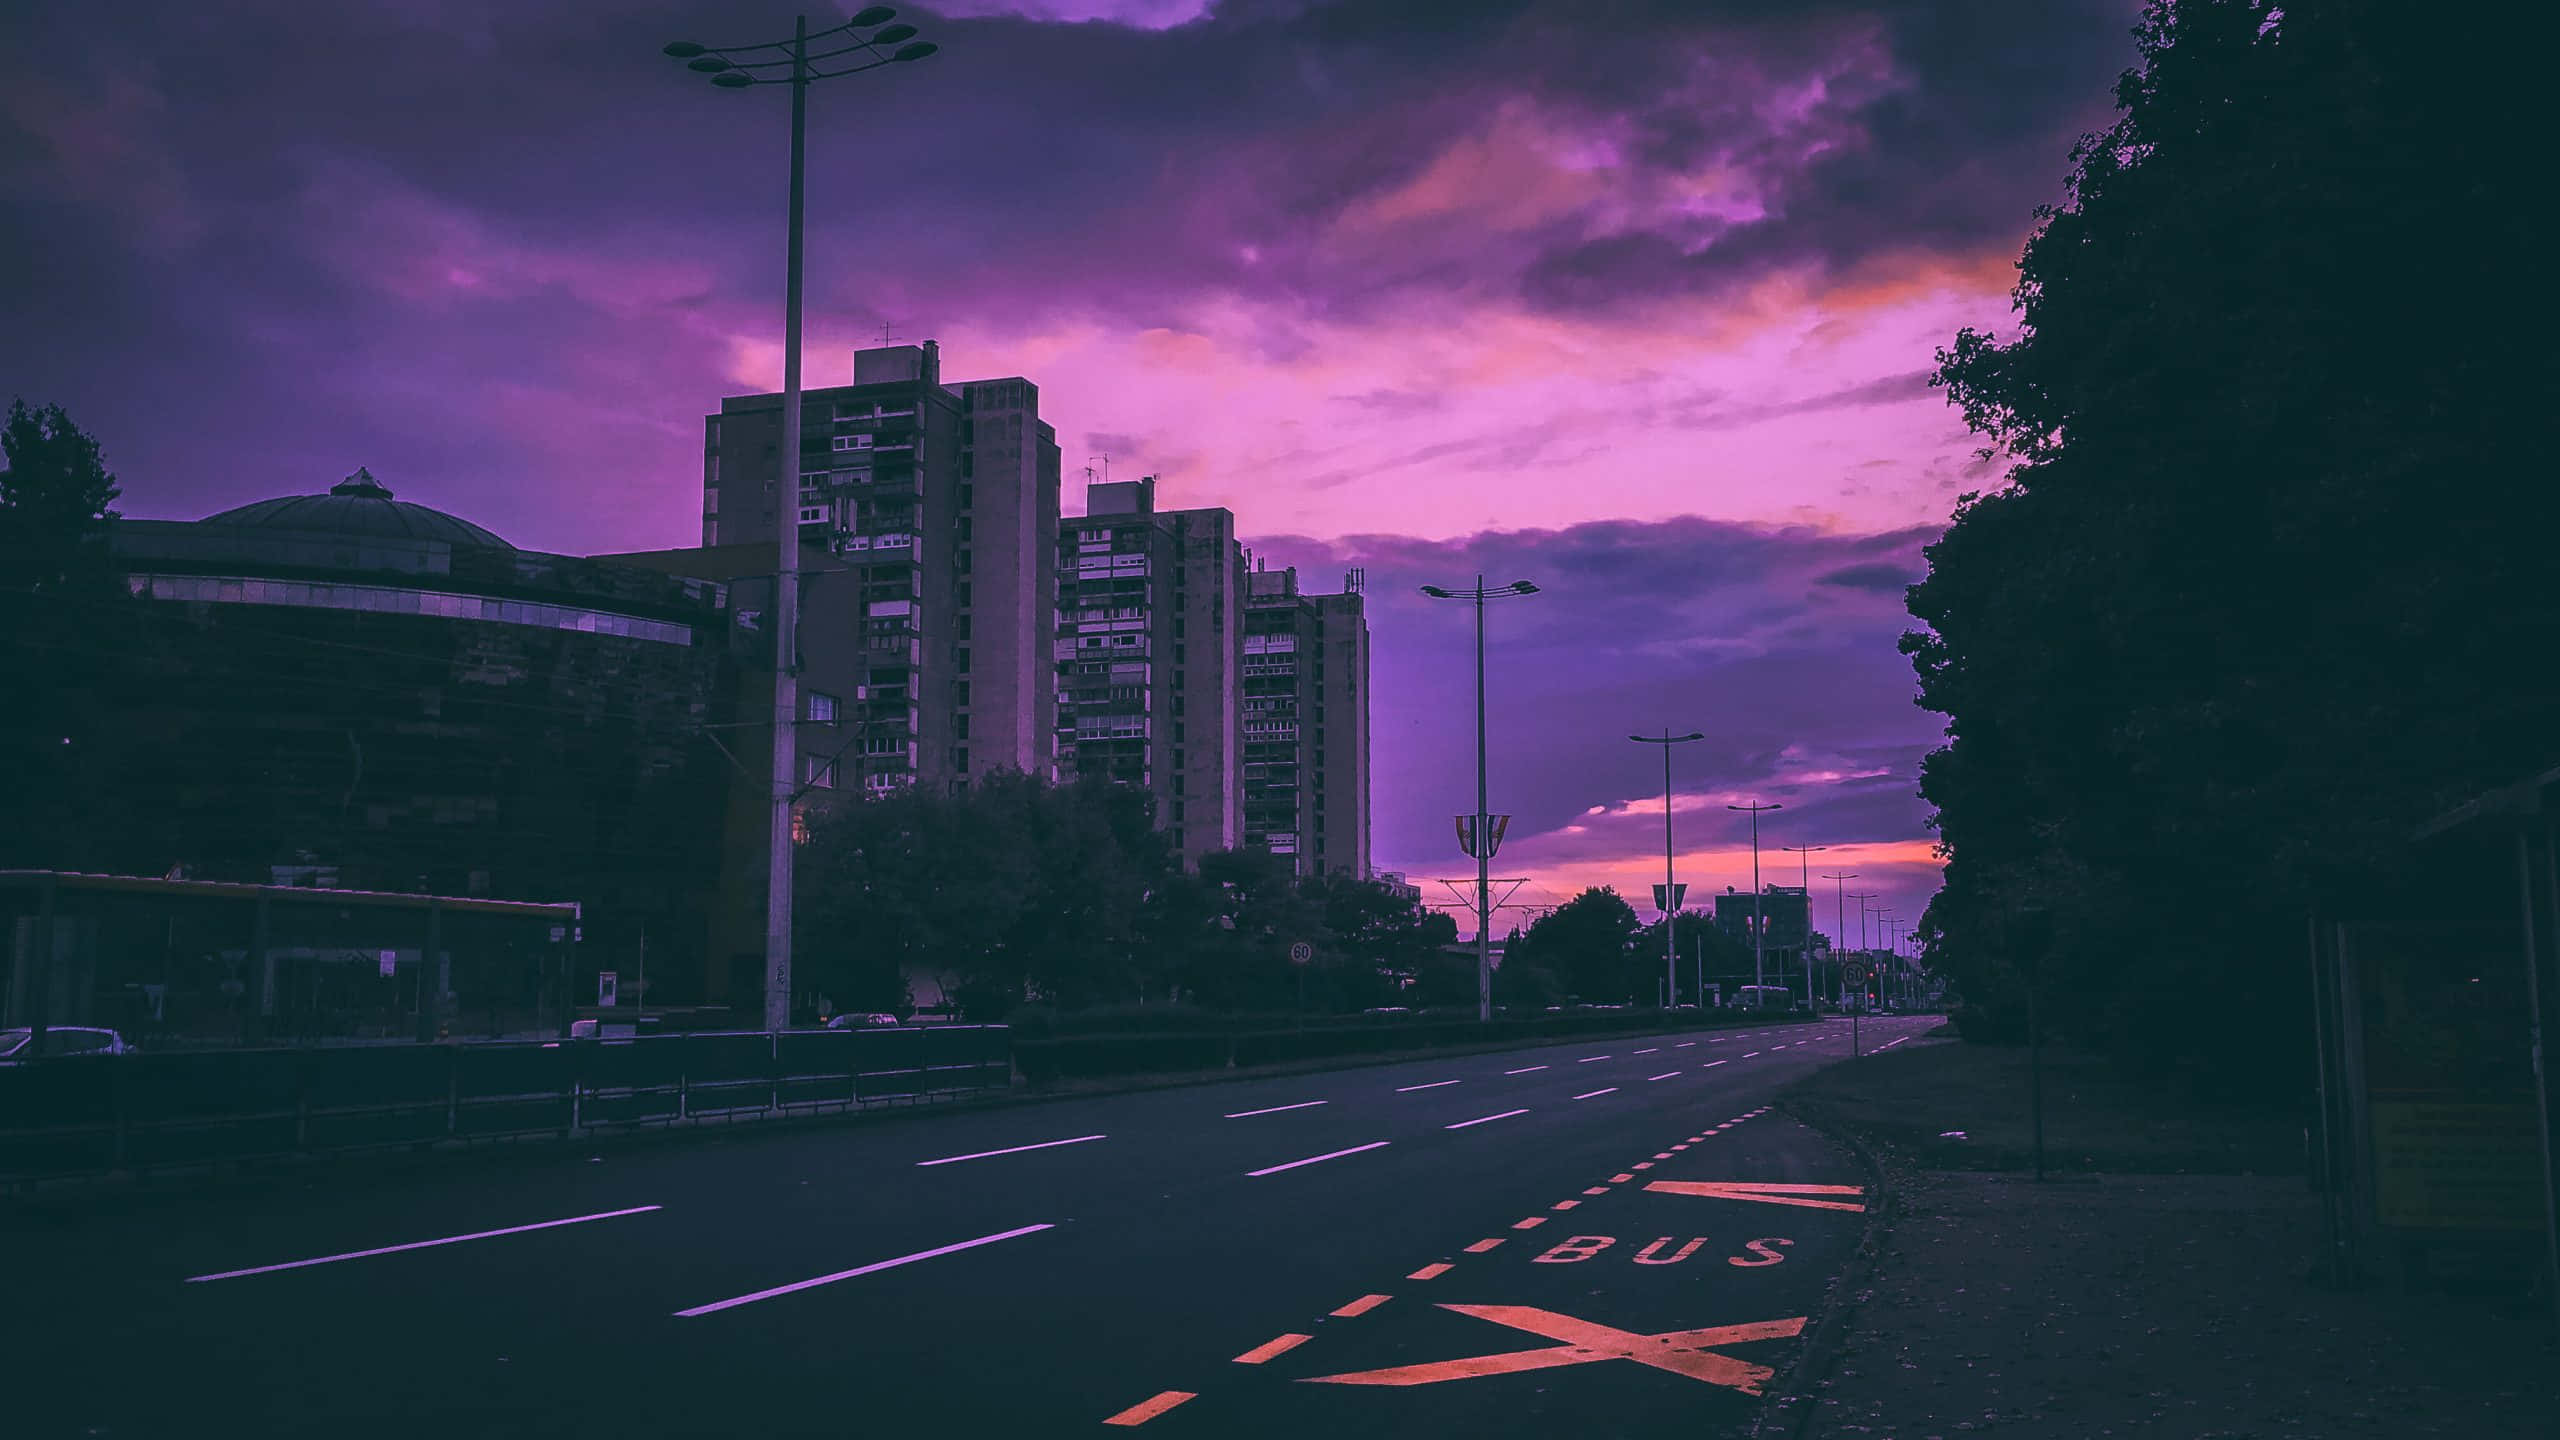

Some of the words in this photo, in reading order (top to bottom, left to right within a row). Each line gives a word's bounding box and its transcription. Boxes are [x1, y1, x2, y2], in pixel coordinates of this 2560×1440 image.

[1294, 945, 1309, 959] 60
[1846, 967, 1864, 981] 60
[1530, 1235, 1795, 1267] BUS
